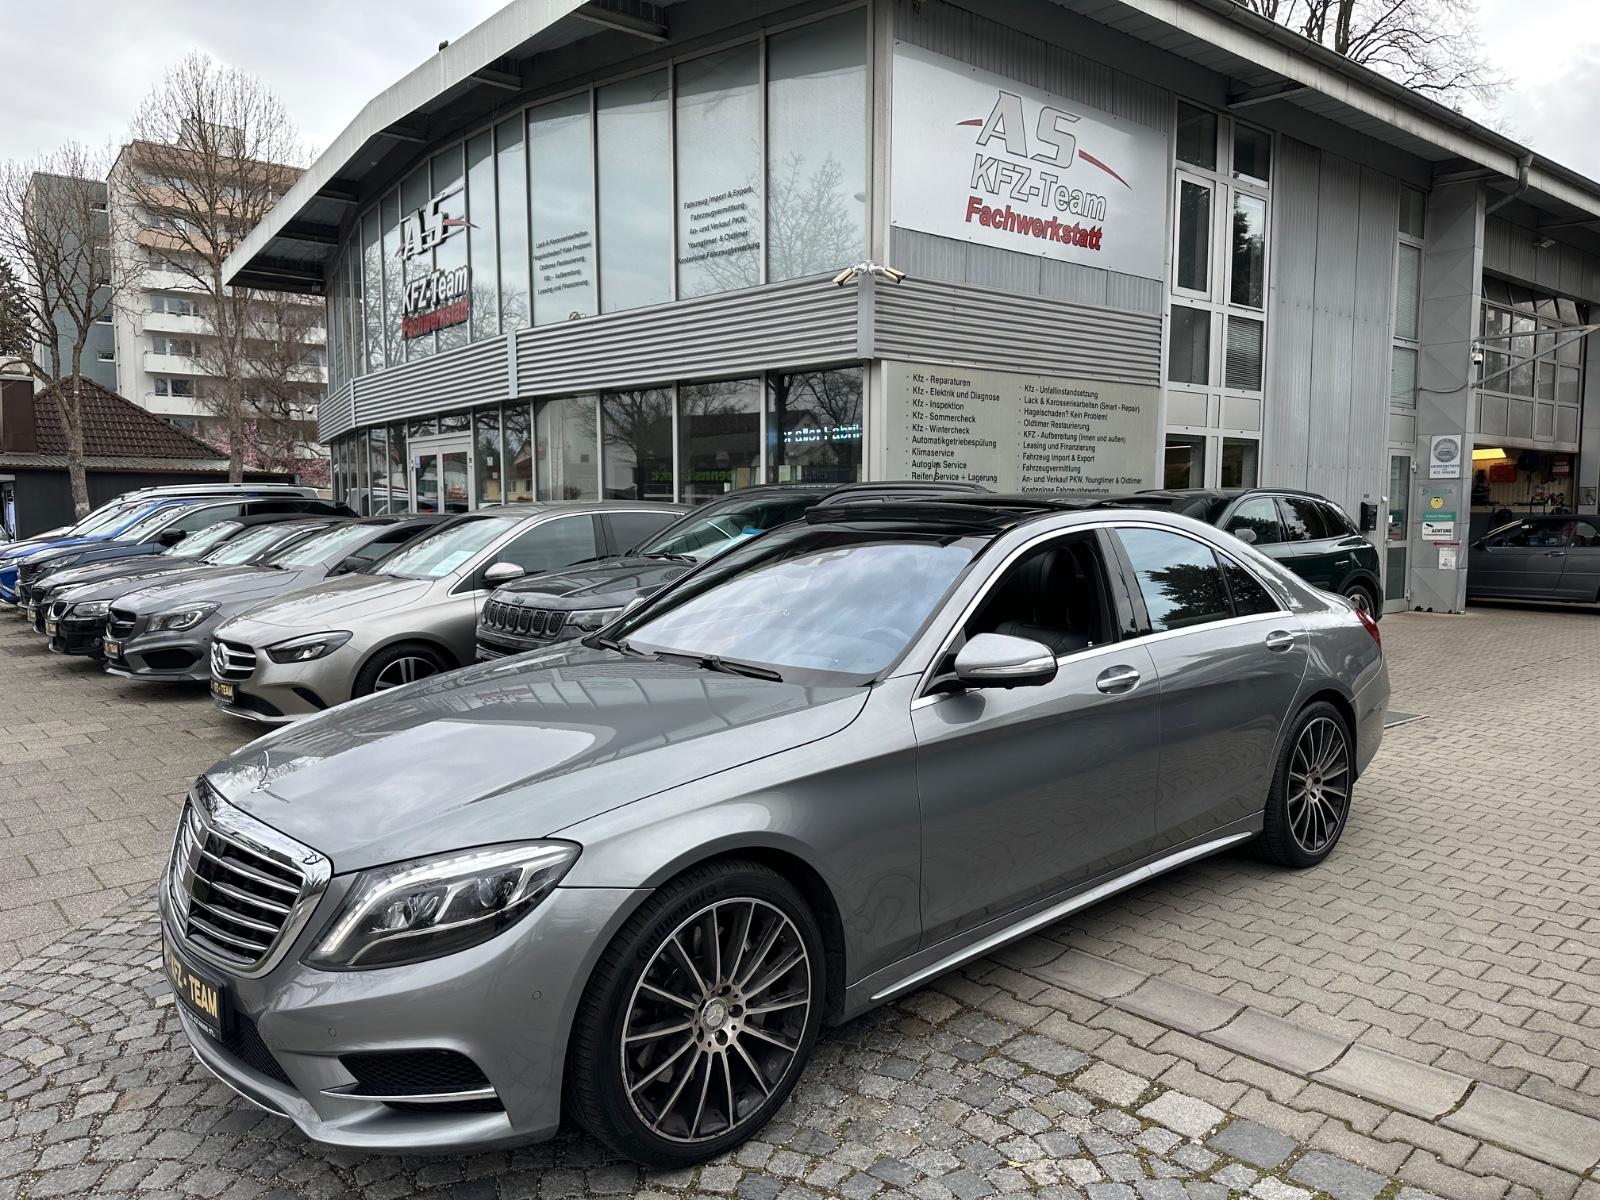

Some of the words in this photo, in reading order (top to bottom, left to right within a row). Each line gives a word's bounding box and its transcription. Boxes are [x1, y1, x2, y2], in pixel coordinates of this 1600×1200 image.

[976, 90, 1082, 169] AS
[970, 153, 1107, 221] KFZ-Team
[684, 198, 708, 209] Fahrzeug
[709, 192, 726, 202] Import
[402, 192, 446, 261] AS
[965, 195, 1103, 251] Fachwerkstatt
[402, 265, 469, 316] KFZ-Team
[912, 373, 924, 382] Kfz
[930, 375, 971, 387] Reparaturen
[912, 386, 924, 395] Kfz
[930, 388, 955, 397] Elektrik
[956, 390, 968, 398] und
[970, 391, 1000, 402] Diagnose
[1040, 386, 1098, 399] Unfallinstandsetzung
[912, 399, 924, 407] Kfz
[930, 400, 964, 410] Inspektion
[1024, 396, 1038, 404] Lack
[1046, 398, 1098, 409] Karosseriearbeiten
[912, 411, 923, 420] Kfz
[929, 412, 976, 423] Sommercheck
[1024, 408, 1068, 418] Hagelschaden?
[1070, 411, 1082, 419] Kein
[1084, 412, 1107, 420] Problem!
[912, 424, 923, 432] Kfz
[929, 425, 970, 434] Wintercheck
[1024, 419, 1049, 427] Oldtimer
[1050, 421, 1089, 431] Restaurierung
[912, 435, 996, 449] Automatikgetriebespülung
[1040, 431, 1077, 442] Aufbereitung
[912, 448, 955, 457] Klimaservice
[1023, 441, 1046, 451] Leasing
[1060, 443, 1095, 453] Finanzierung
[1023, 452, 1050, 462] Fahrzeug
[1051, 454, 1070, 463] Import
[1077, 455, 1095, 463] Export
[912, 460, 941, 470] Autoglas
[943, 460, 967, 469] Service
[1022, 463, 1081, 473] Fahrzeugvermittlung
[912, 472, 934, 480] Reifen
[935, 473, 959, 481] Service
[968, 473, 998, 483] Lagerung
[1047, 475, 1068, 483] Verkauf
[188, 973, 217, 1019] TEAM
